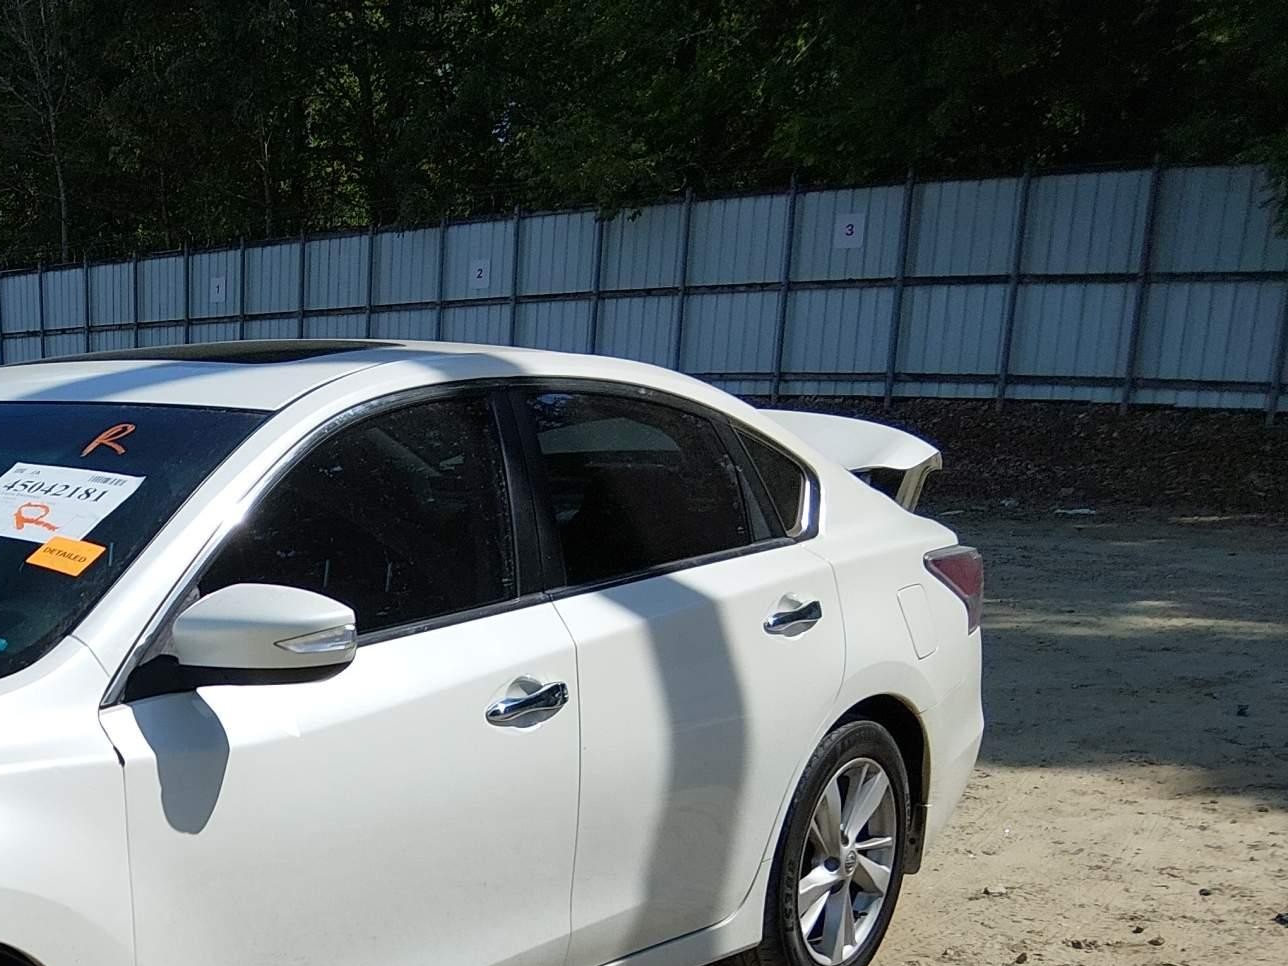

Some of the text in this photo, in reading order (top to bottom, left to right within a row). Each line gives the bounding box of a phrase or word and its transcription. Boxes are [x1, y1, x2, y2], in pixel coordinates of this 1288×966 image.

[845, 223, 855, 237] 3
[476, 268, 483, 279] 2
[80, 423, 136, 457] R
[4, 479, 109, 502] 45042181
[14, 502, 60, 531] R
[43, 546, 87, 563] DETAILED
